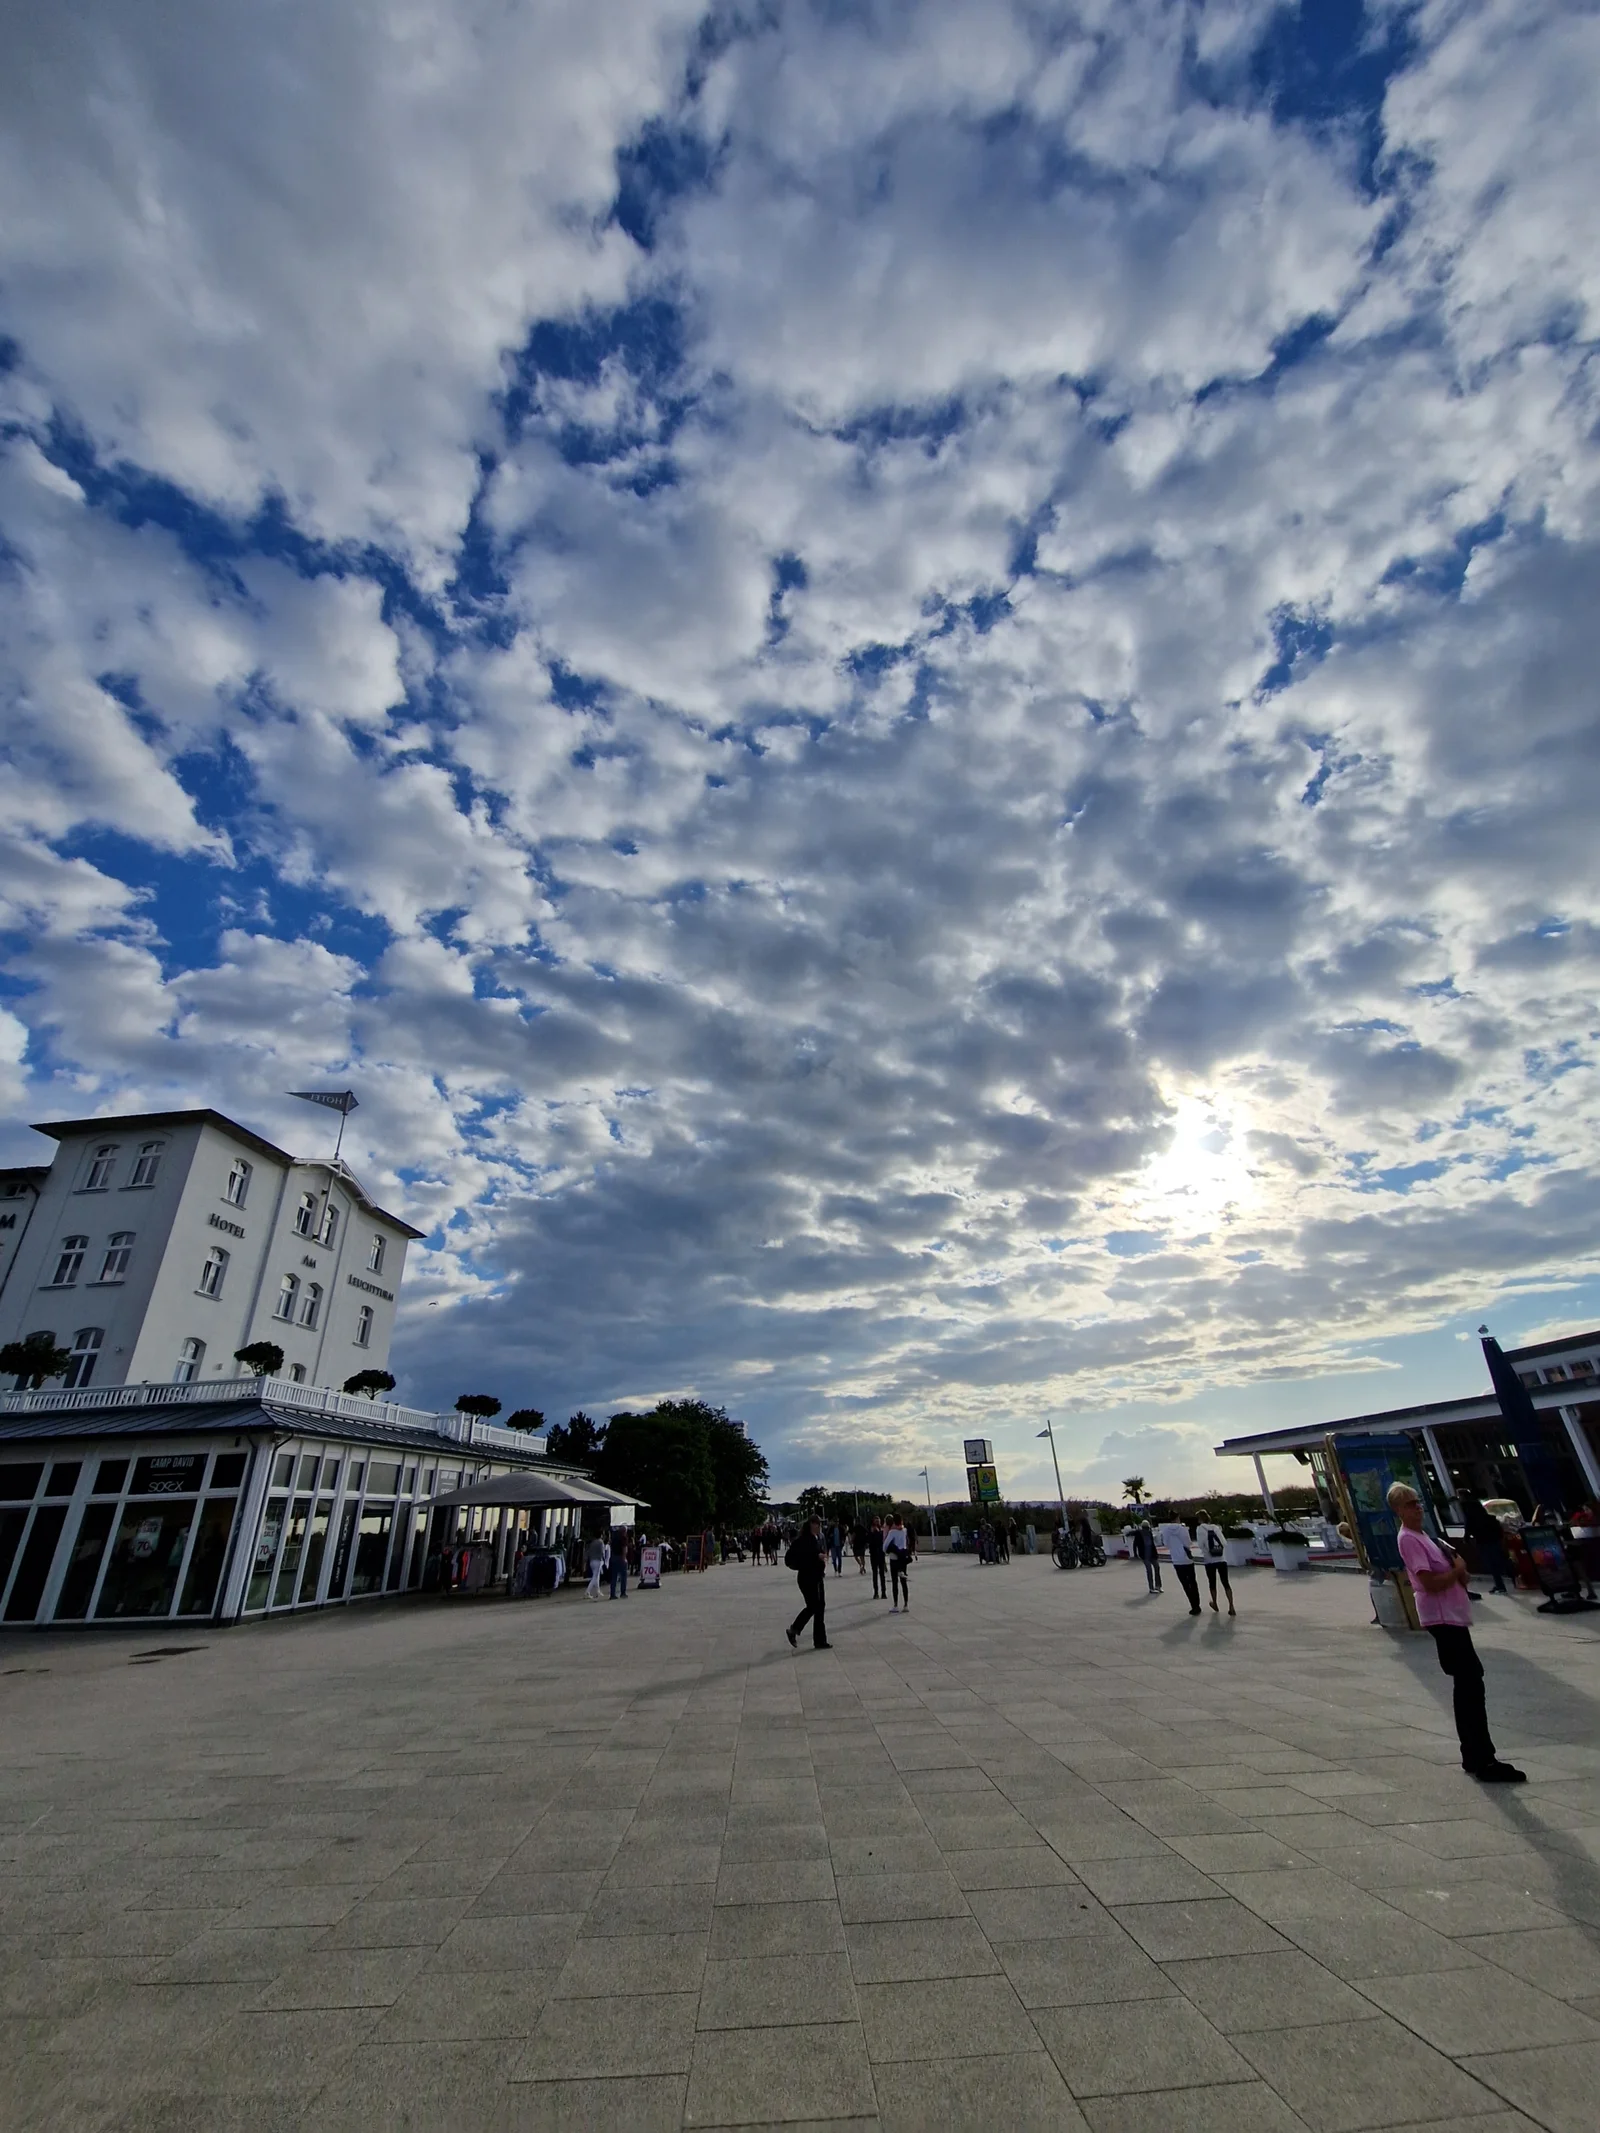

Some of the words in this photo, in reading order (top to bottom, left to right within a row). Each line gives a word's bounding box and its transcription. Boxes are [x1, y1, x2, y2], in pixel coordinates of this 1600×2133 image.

[209, 1212, 246, 1239] HOTEL
[302, 1254, 317, 1269] AM
[150, 1457, 172, 1469] CAMP
[172, 1456, 195, 1468] DAVID
